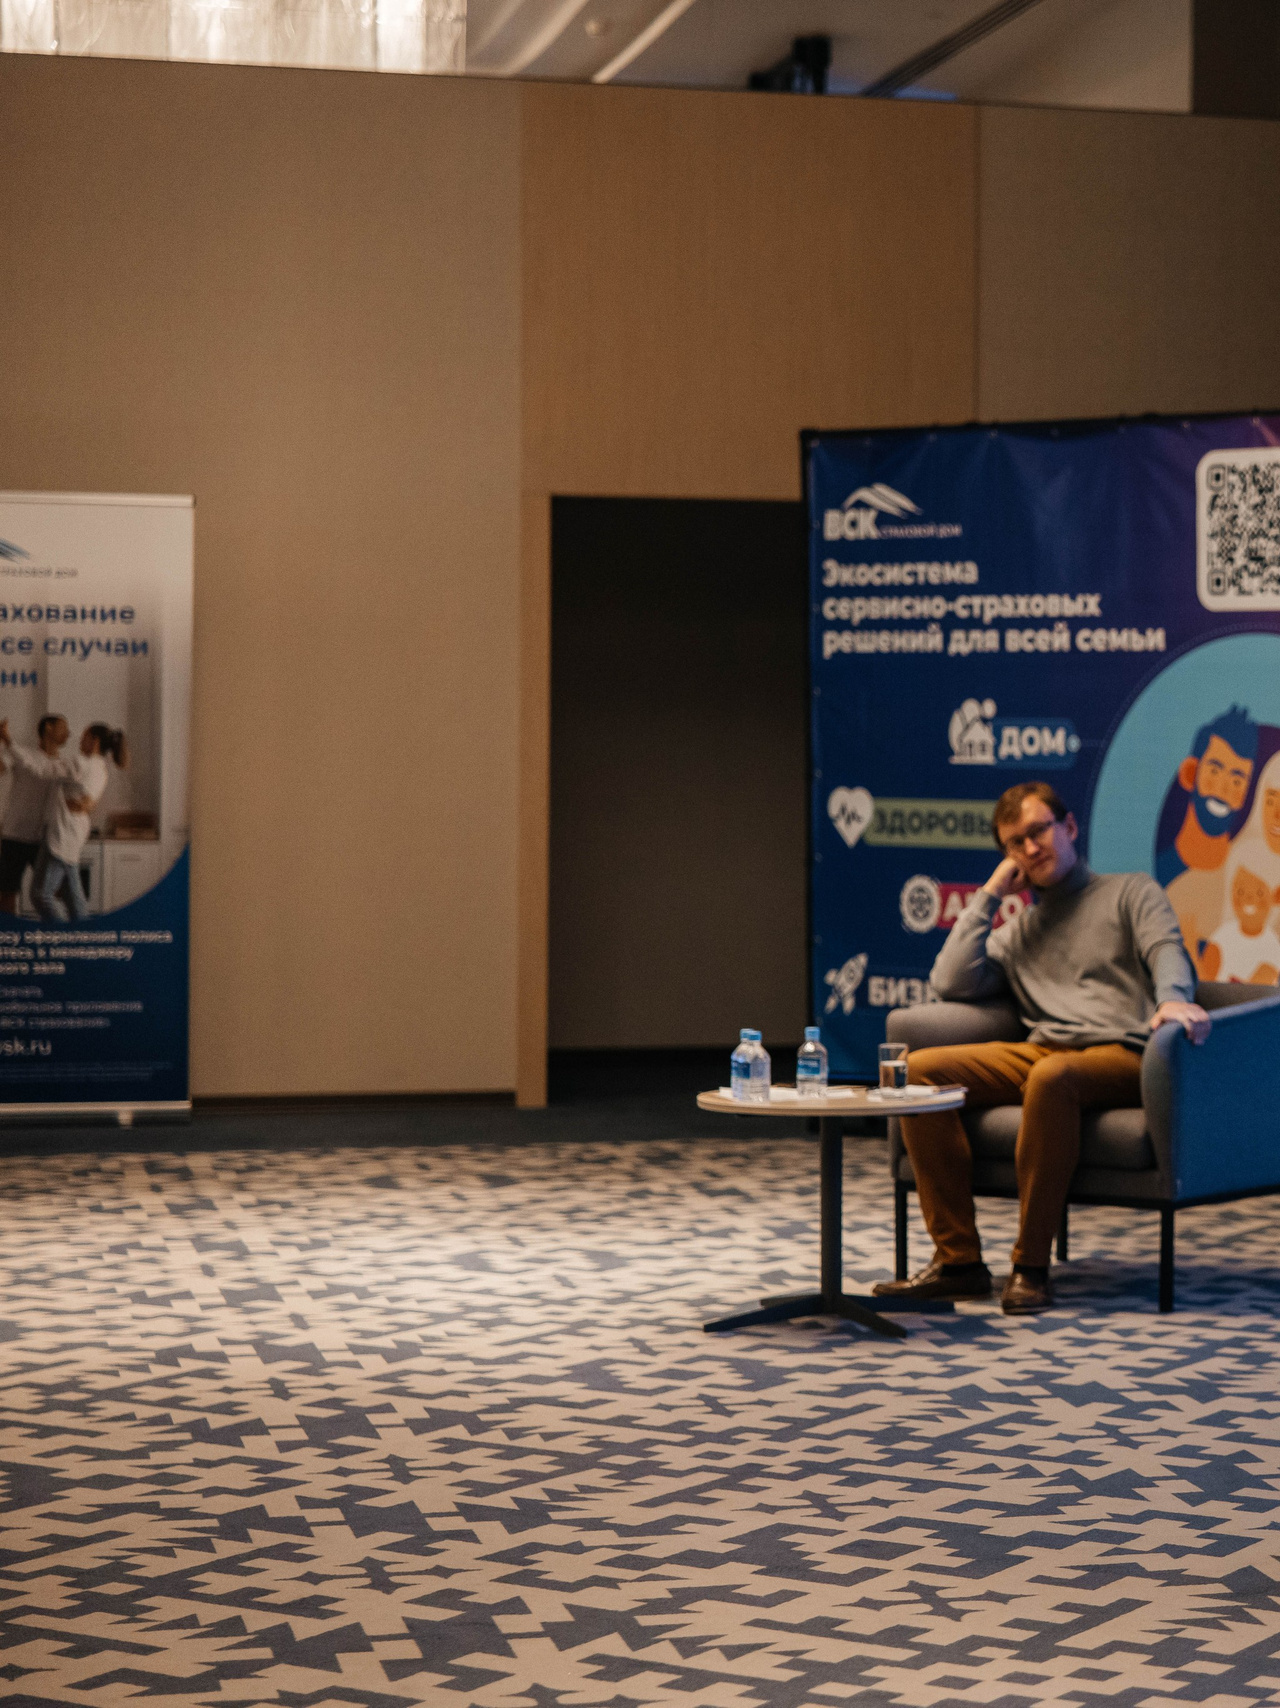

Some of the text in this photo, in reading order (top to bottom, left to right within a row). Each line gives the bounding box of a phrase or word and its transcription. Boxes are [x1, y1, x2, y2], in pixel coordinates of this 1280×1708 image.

[823, 509, 880, 541] ВСК
[822, 559, 979, 587] Экосистема
[822, 593, 1102, 626] сервисно-страховых
[43, 637, 149, 661] случаи
[822, 621, 1166, 660] решений для всей семьи
[998, 726, 1067, 761] ДОМ
[874, 808, 994, 837] ЗДОРОВЬ
